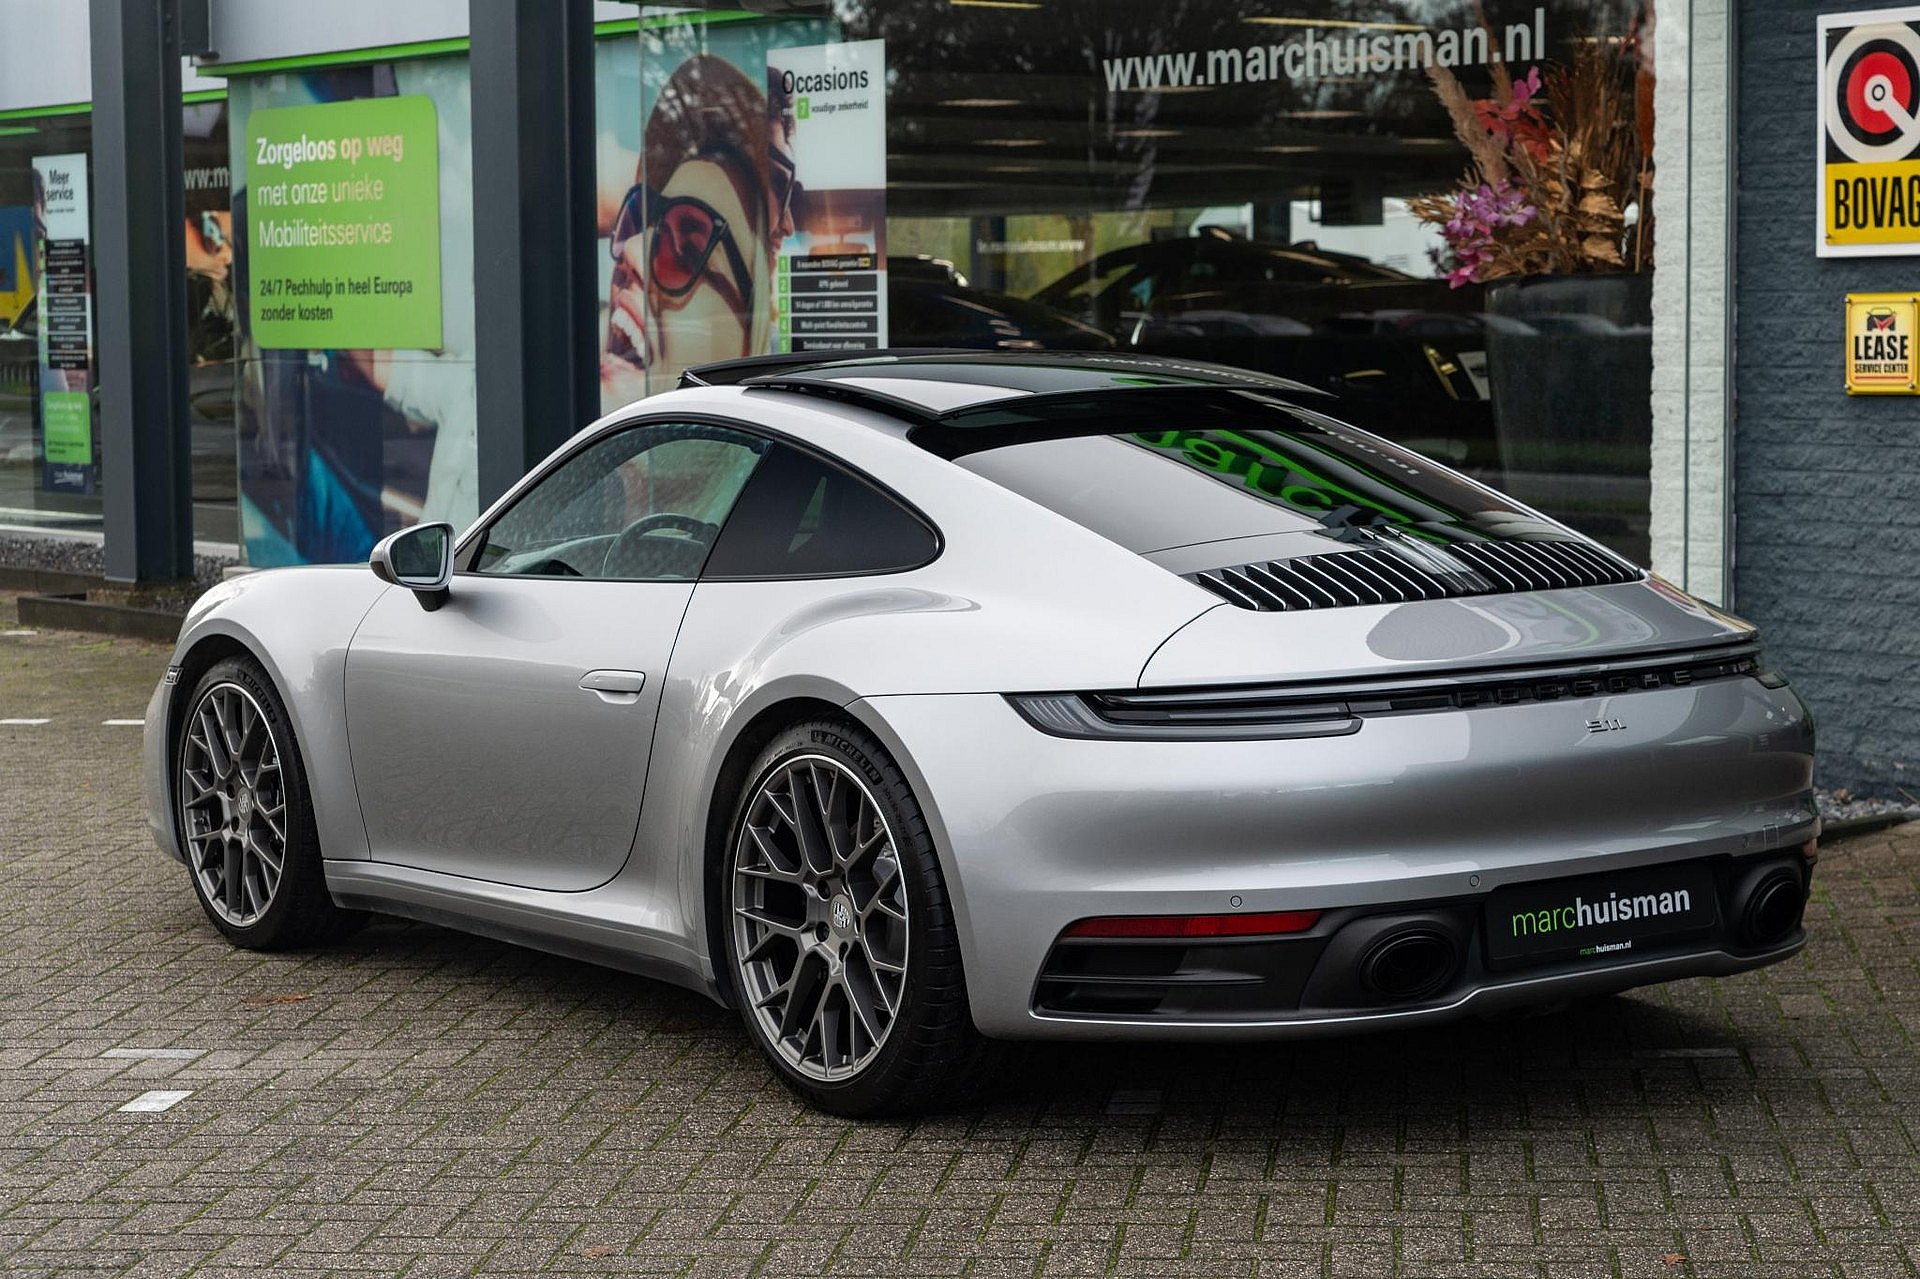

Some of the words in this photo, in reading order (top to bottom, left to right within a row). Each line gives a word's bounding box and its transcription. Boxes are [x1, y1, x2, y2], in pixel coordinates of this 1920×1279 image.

[1102, 7, 1546, 93] www.marchuisman.nl
[782, 66, 869, 94] Occasions
[256, 134, 337, 170] Zorgeloos
[340, 137, 362, 165] op
[366, 134, 404, 161] weg
[49, 168, 70, 185] Meer
[46, 187, 74, 202] service
[258, 181, 288, 207] met
[291, 182, 328, 204] onze
[331, 173, 384, 203] unieke
[1834, 175, 1920, 230] BOVAG
[259, 216, 393, 248] Mobiliteitsservice
[260, 279, 283, 297] 24/7
[285, 278, 333, 299] Pechhulp
[335, 277, 346, 294] in
[348, 276, 371, 294] heel
[374, 275, 413, 297] Europa
[261, 305, 295, 321] zonder
[298, 303, 333, 321] kosten
[1854, 335, 1909, 360] LEASE
[1854, 363, 1881, 374] SERVICE
[1883, 363, 1908, 374] CENTER
[1585, 717, 1628, 733] 911
[824, 732, 882, 783] MICHELIN
[1512, 889, 1691, 938] marchuisman
[1579, 940, 1632, 955] marchuisman.nl
